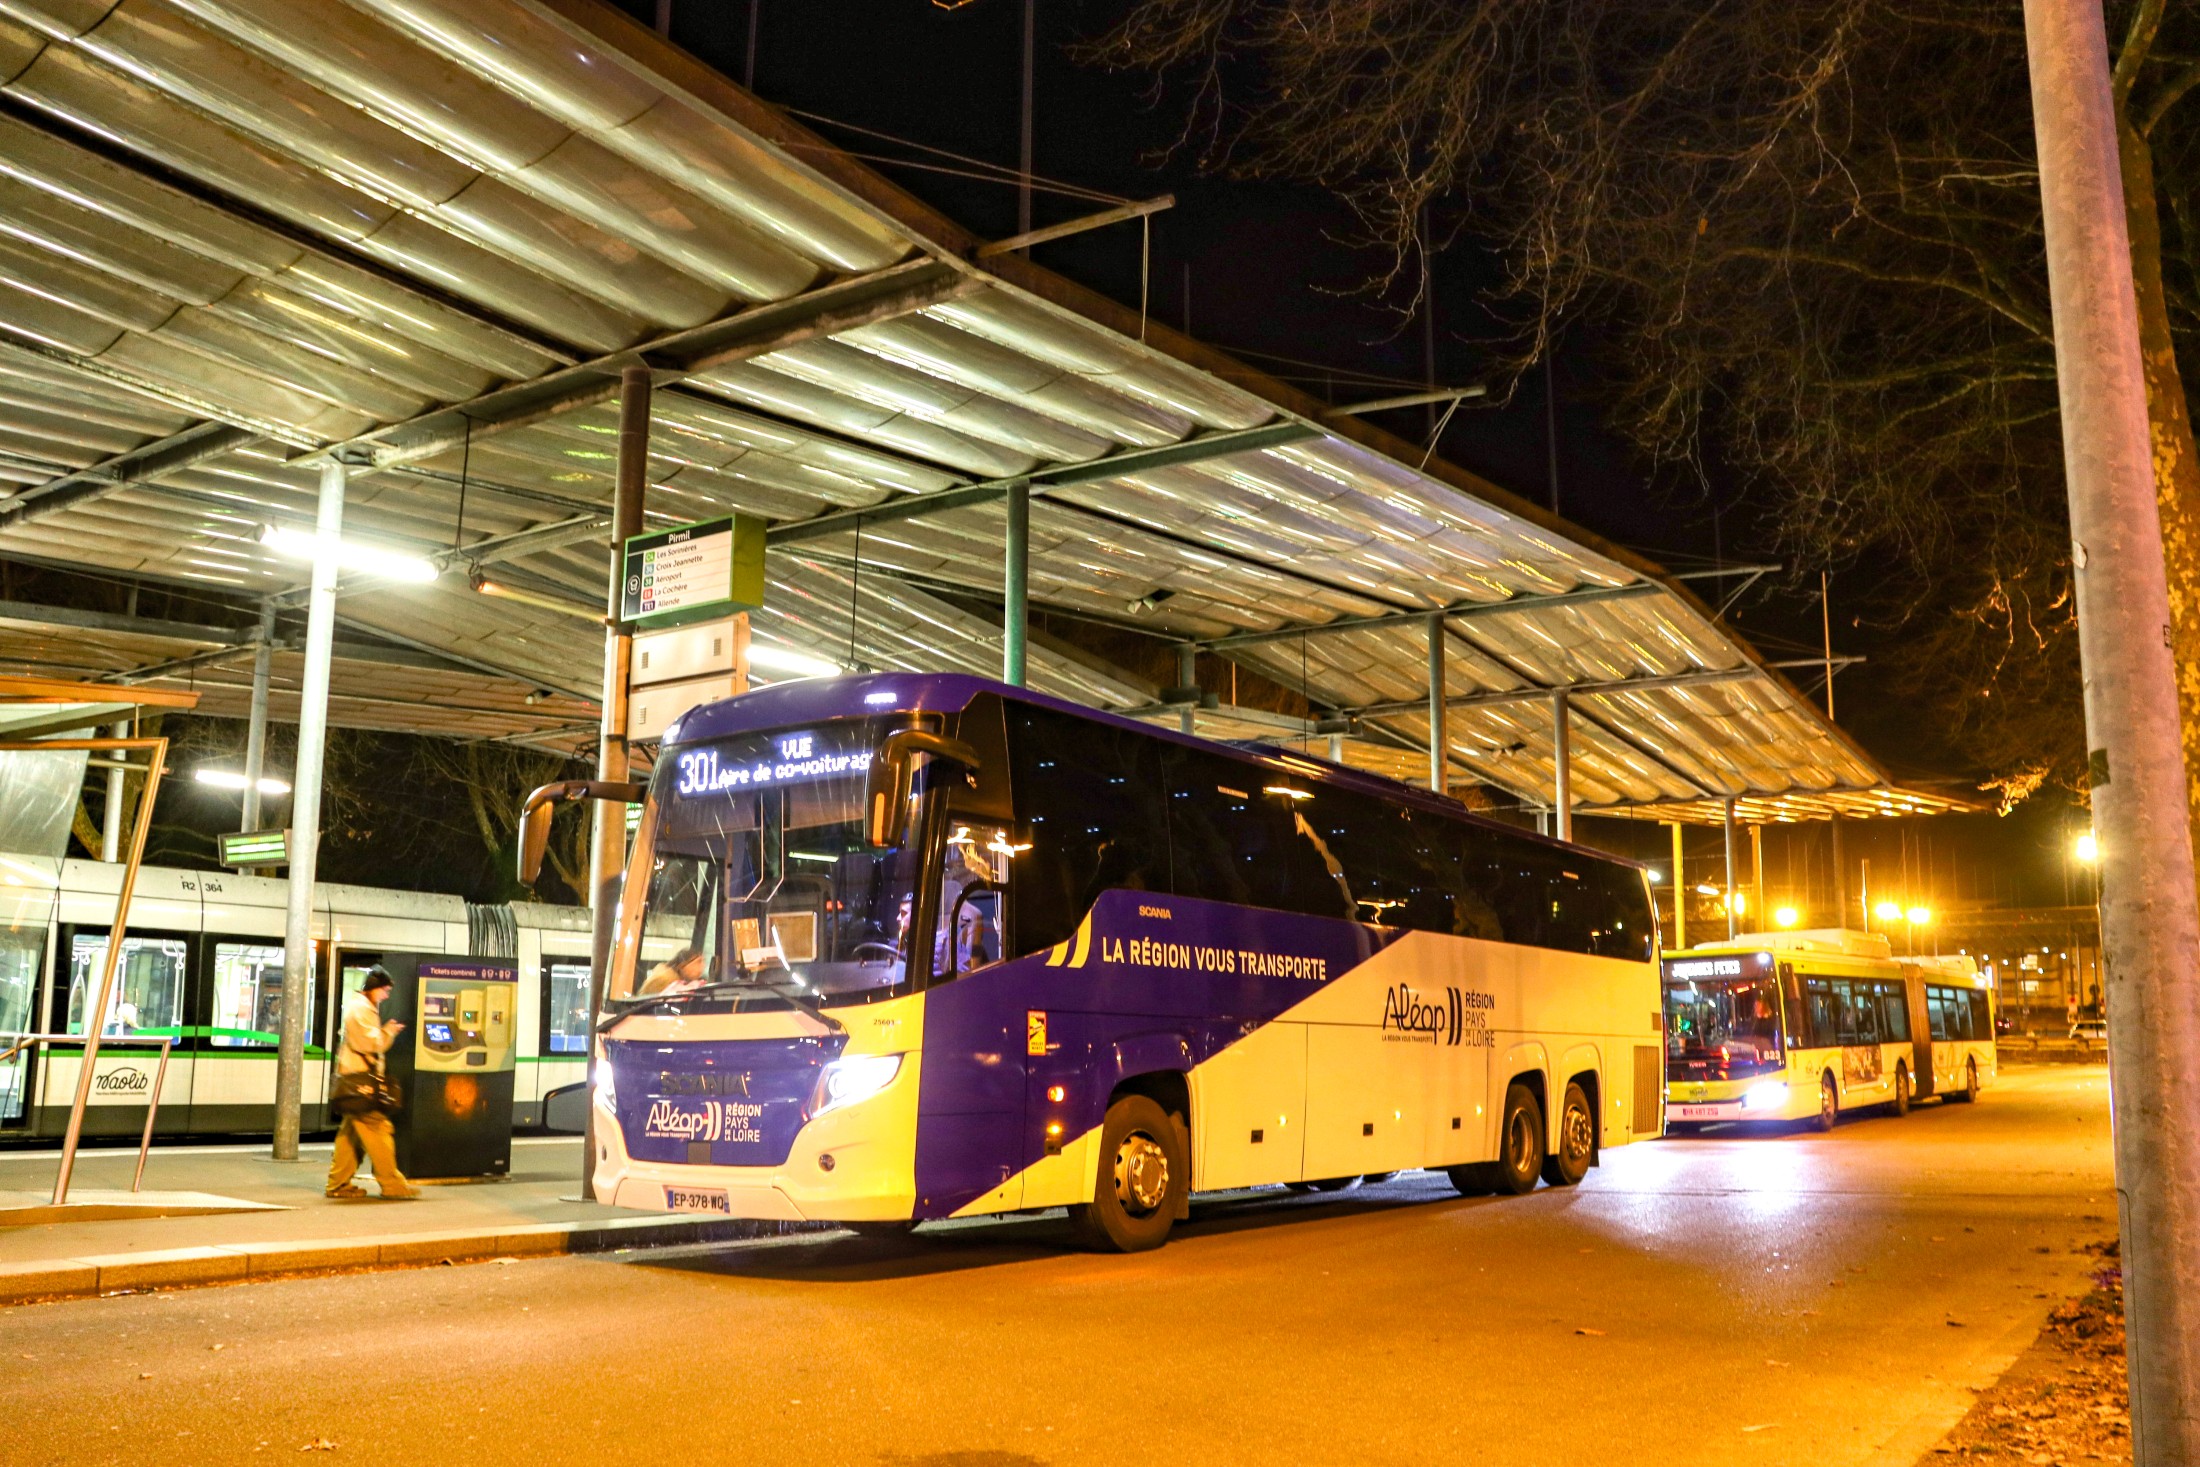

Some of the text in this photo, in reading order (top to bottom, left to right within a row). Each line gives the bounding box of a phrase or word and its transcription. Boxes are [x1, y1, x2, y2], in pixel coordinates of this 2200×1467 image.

[668, 530, 691, 544] Pirmil
[656, 551, 667, 559] Les
[667, 545, 697, 556] Sorinières
[656, 562, 672, 571] Croix
[673, 555, 703, 567] Jeannette
[656, 572, 682, 583] Aéroport
[662, 584, 688, 594] Cochère
[657, 598, 680, 607] Allende
[781, 737, 813, 760] VUE
[679, 751, 719, 794] 301
[717, 767, 750, 789] Aire
[752, 764, 772, 782] de
[181, 881, 223, 892] R2 364
[1138, 905, 1172, 920] SCANIA
[1102, 936, 1327, 981] LA RÉGION VOUS TRANSPORTE
[430, 967, 450, 975] Tickets
[1465, 989, 1495, 1010] RÉGION
[1382, 982, 1446, 1045] Aléop
[1465, 1011, 1486, 1029] PAYS
[1472, 1030, 1496, 1048] LOIRE
[661, 1074, 750, 1095] SCANIA
[725, 1102, 762, 1117] RÉGION
[645, 1100, 704, 1140] Aléop
[725, 1117, 749, 1129] PAYS
[732, 1130, 760, 1142] LOIRE
